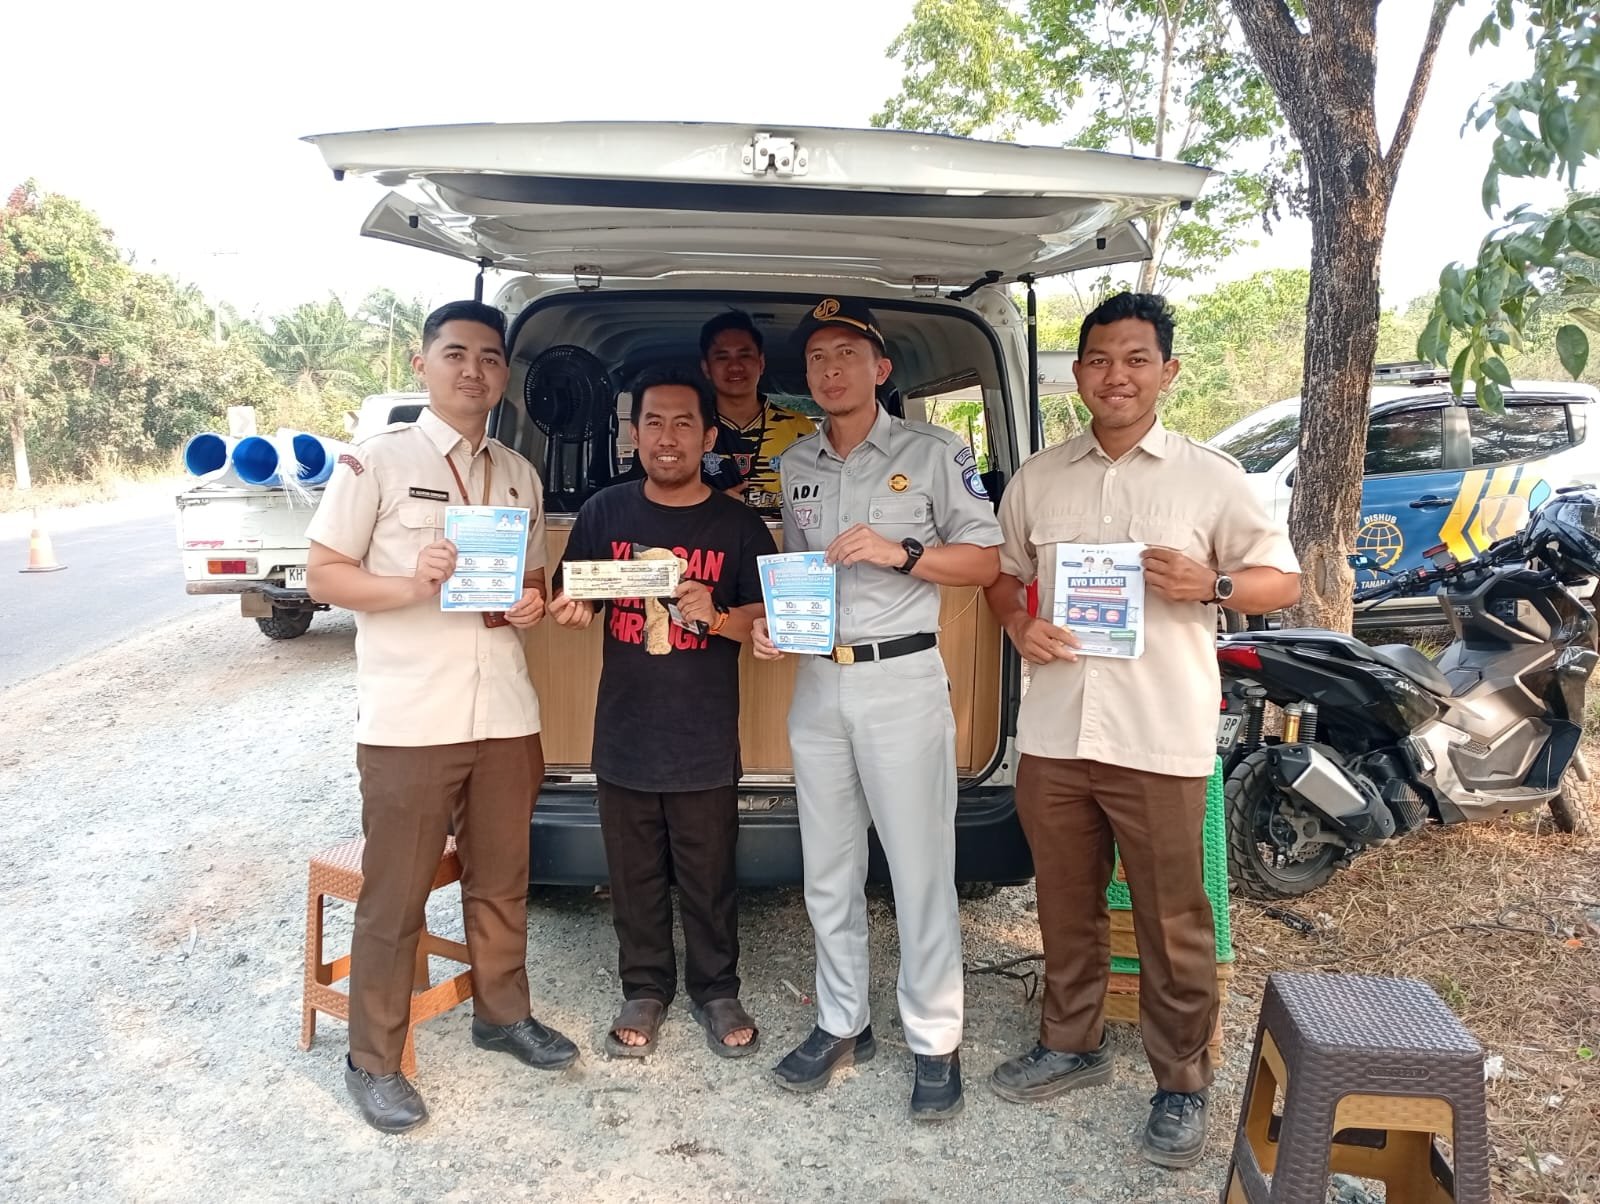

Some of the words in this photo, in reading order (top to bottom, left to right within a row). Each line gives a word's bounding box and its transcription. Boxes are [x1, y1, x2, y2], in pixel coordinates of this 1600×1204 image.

[793, 485, 819, 500] ADI
[1363, 513, 1397, 524] DISHUB
[1070, 578, 1088, 587] AYO
[1361, 580, 1386, 588] TANAH
[1223, 718, 1238, 731] BP
